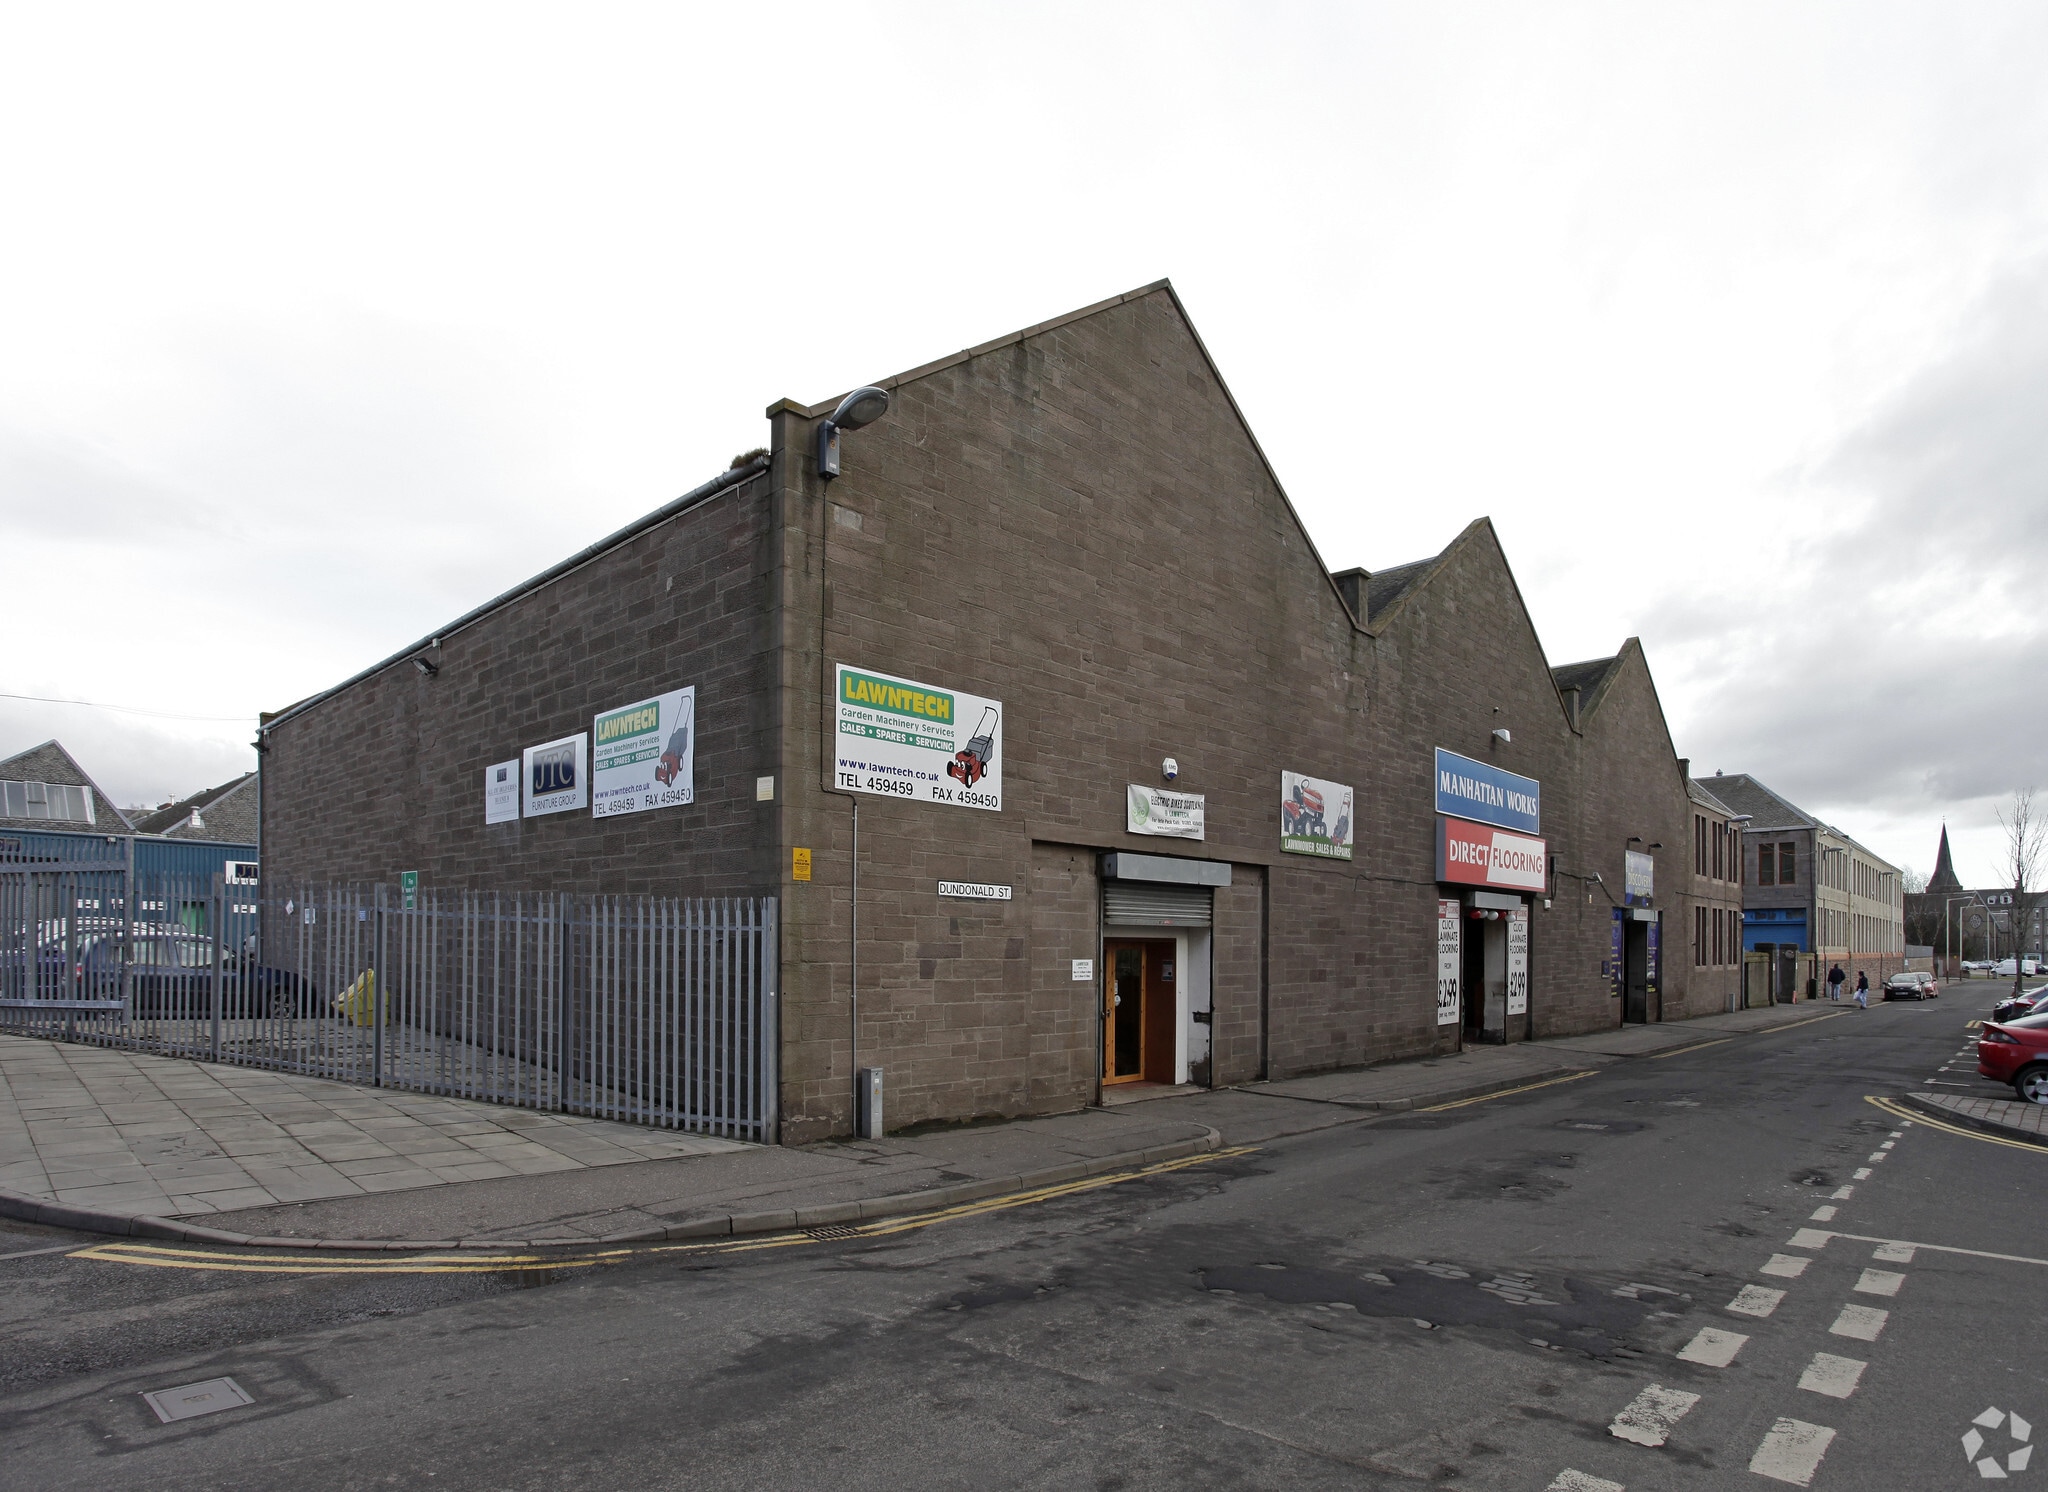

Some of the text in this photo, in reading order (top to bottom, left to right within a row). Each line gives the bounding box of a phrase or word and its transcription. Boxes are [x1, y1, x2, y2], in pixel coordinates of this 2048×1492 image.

[846, 677, 949, 719] LAWNTECH
[598, 706, 657, 740] LAWNTECH
[841, 707, 955, 738] Garden Machinery Services
[596, 735, 660, 757] Garden Machinery Services
[841, 722, 953, 752] SALES SPARES SERVICING
[596, 747, 659, 770] SALES SPARES SERVICING
[535, 749, 572, 790] JTC
[839, 758, 939, 782] www.lawntech.co.uk
[594, 782, 650, 799] www.lawntech.co.uk
[839, 772, 914, 796] TEL 459459
[1440, 770, 1537, 817] MANHATTAN WORKS
[532, 793, 577, 811] FURNITURE GROUP
[595, 797, 635, 815] TEL 459459
[645, 788, 691, 807] FAX 459450
[932, 787, 998, 808] FAX 459450
[1284, 838, 1315, 853] LAWNMOWER
[1315, 842, 1330, 855] SALES
[1334, 846, 1351, 858] REPAIRS
[1449, 839, 1543, 874] DIRECT FLOORING
[940, 883, 1011, 898] DUNDONALD ST.
[1628, 872, 1651, 888] DISCOVERY
[1442, 920, 1455, 930] CLICK
[1513, 923, 1523, 932] CLICK
[1510, 934, 1527, 943] LAMINATE
